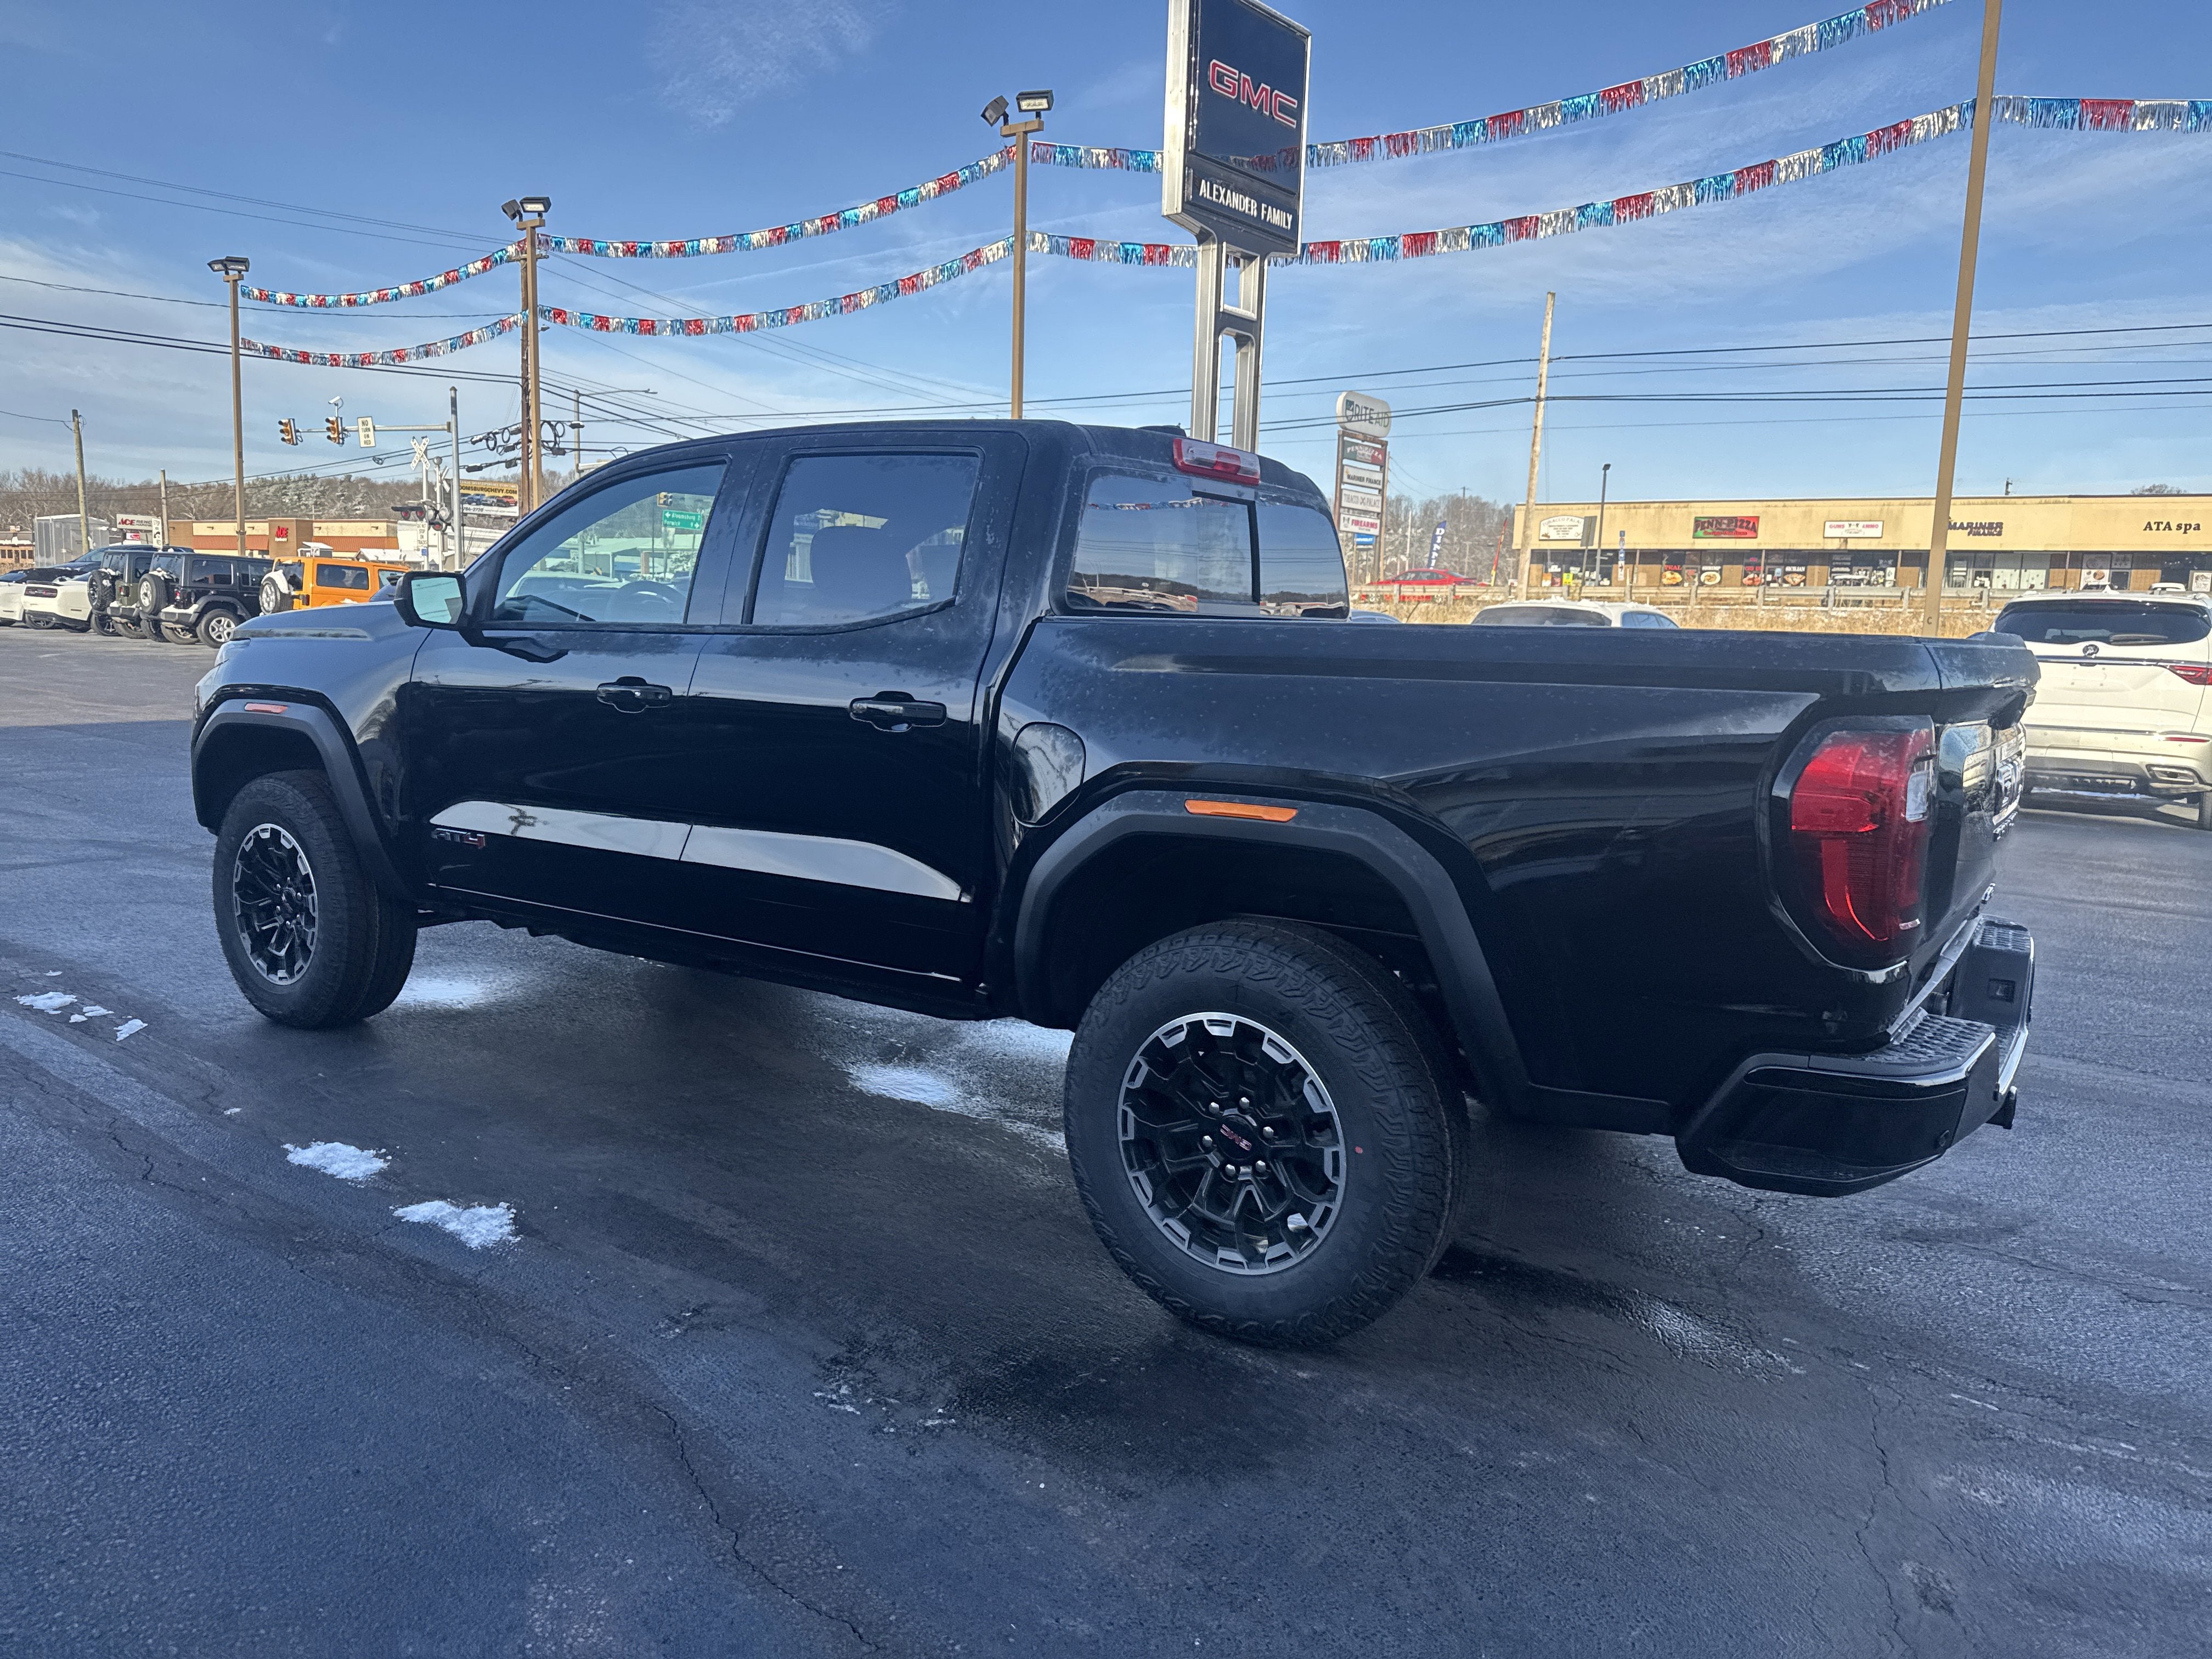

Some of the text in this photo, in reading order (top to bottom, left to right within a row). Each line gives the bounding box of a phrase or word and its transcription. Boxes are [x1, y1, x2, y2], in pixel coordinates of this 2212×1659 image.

[1210, 59, 1297, 128] GMC
[1199, 179, 1293, 230] ALEXANDER FAMILY
[1355, 404, 1390, 427] RITE AID
[1347, 473, 1364, 482] MARINER
[1351, 519, 1378, 529] FIREARMS
[1542, 517, 1565, 527] TOBACCO
[1948, 522, 2004, 531] MARINER
[2142, 521, 2201, 534] ATA spa
[275, 526, 289, 538] ACE
[1430, 528, 1445, 569] DINNI
[431, 828, 486, 849] AT4
[1220, 1124, 1252, 1151] GMC
